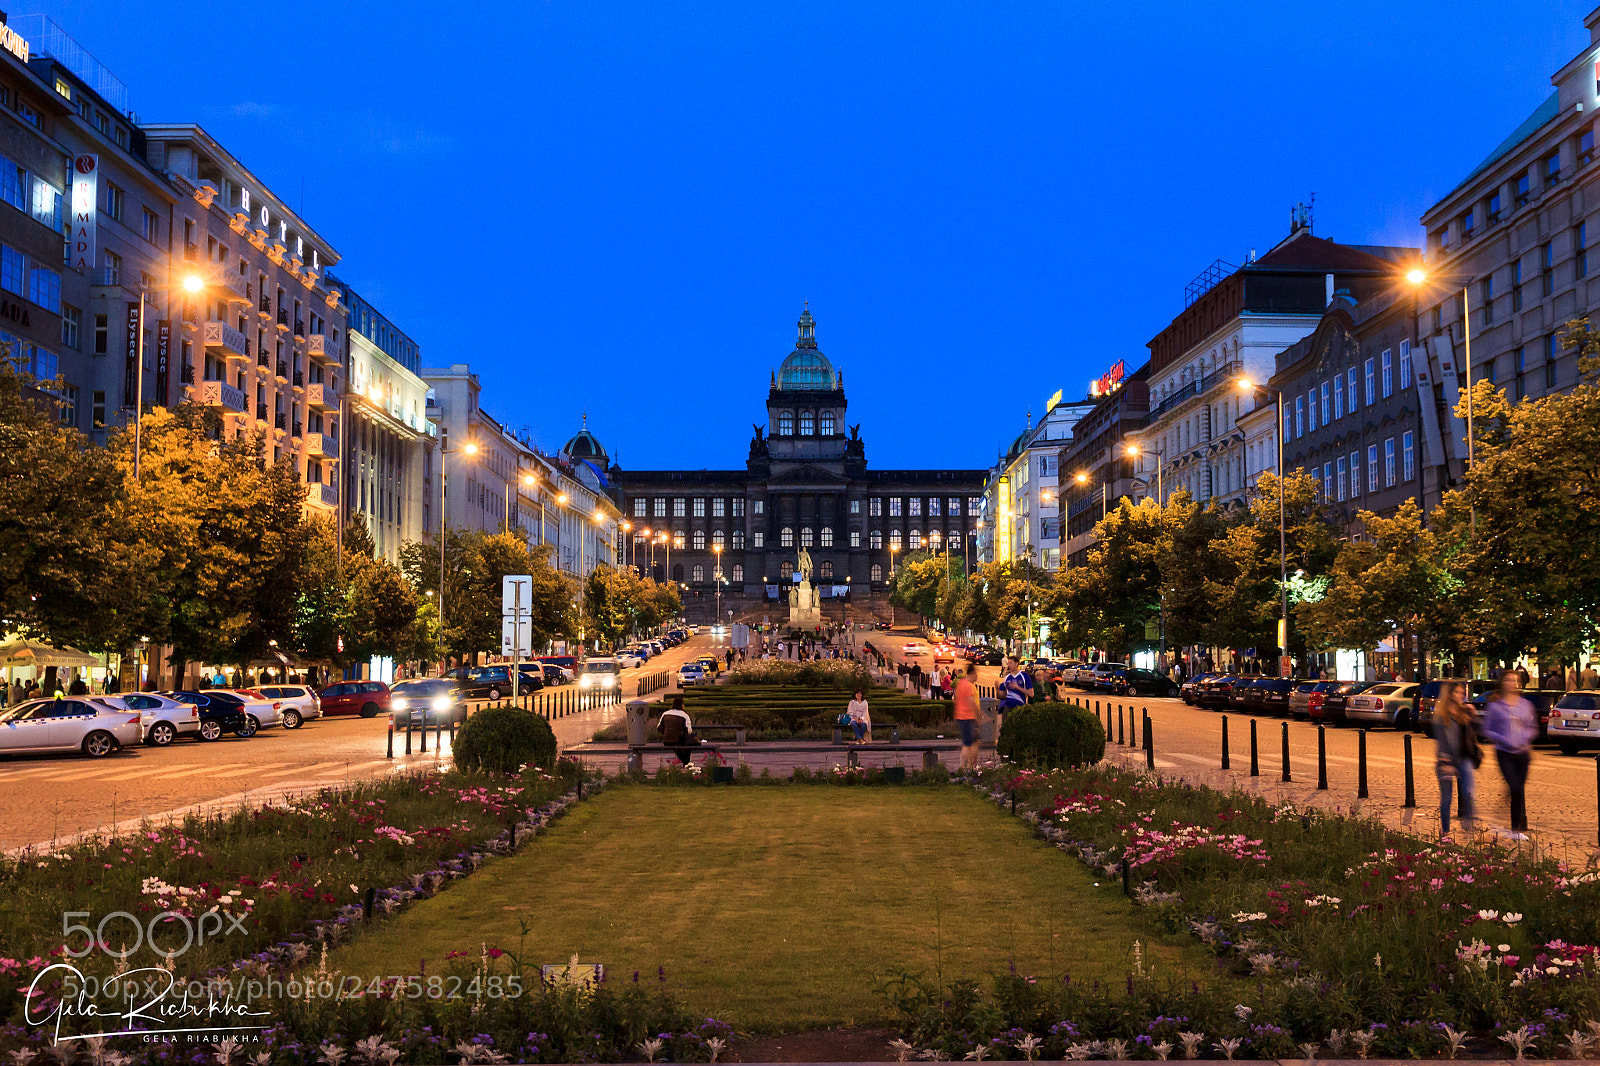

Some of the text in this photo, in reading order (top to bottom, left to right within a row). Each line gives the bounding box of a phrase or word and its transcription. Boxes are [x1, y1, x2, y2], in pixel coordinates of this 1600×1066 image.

[76, 182, 89, 267] RAMADA
[241, 187, 319, 271] HOTEL
[128, 308, 138, 358] Elysee
